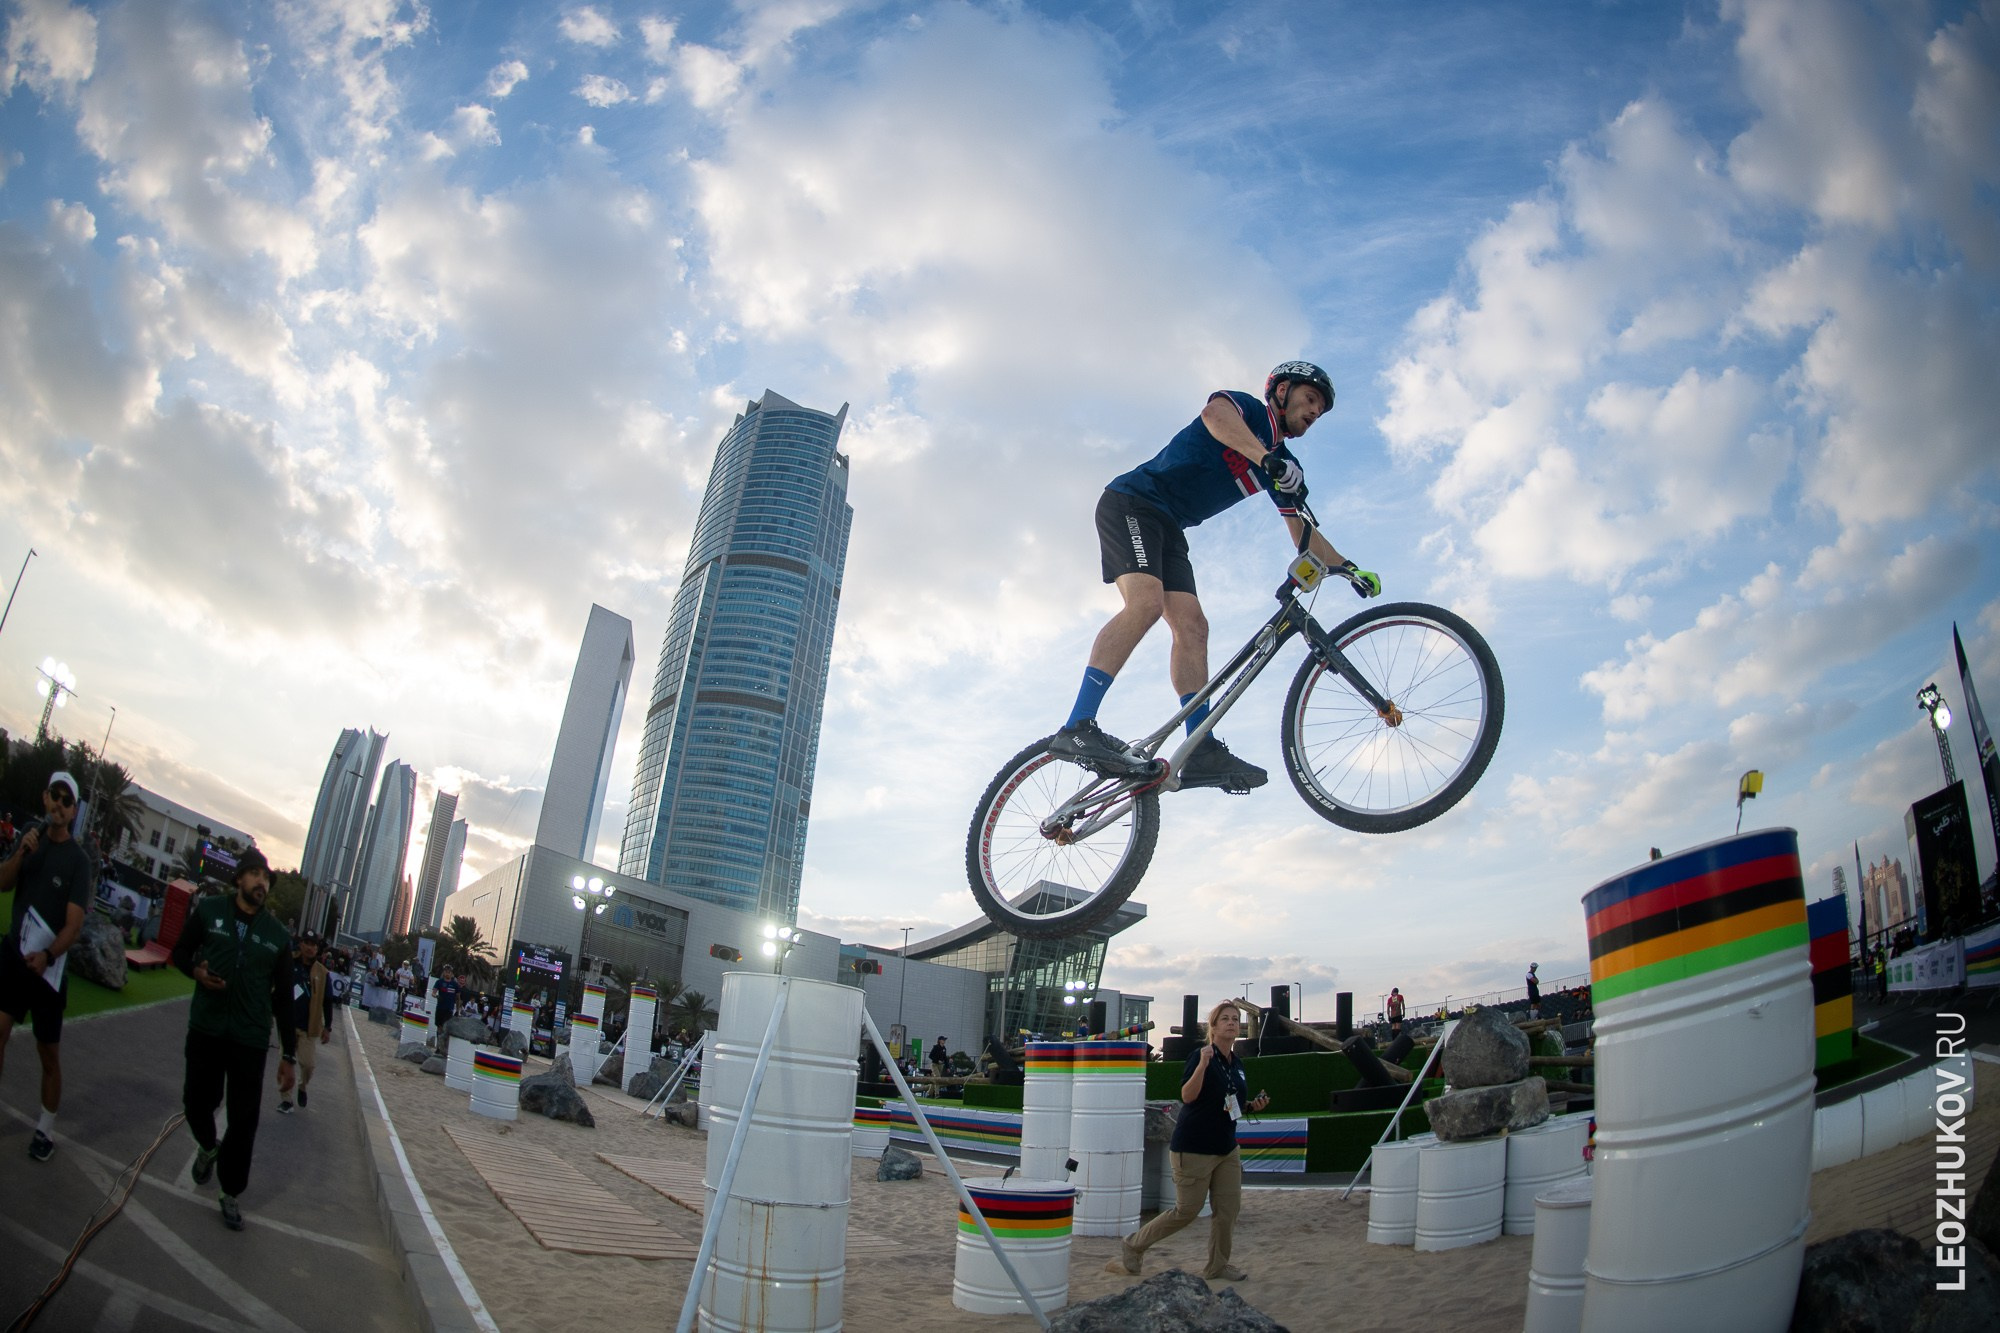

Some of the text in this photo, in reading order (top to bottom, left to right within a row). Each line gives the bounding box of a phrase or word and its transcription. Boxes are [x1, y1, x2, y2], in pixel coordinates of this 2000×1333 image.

[1131, 535, 1148, 568] CONTROL
[1303, 569, 1315, 582] 2
[1305, 784, 1322, 800] TIRE
[1320, 798, 1336, 811] VEE
[637, 910, 668, 933] VOX
[354, 973, 362, 983] 2
[672, 1050, 679, 1060] 3
